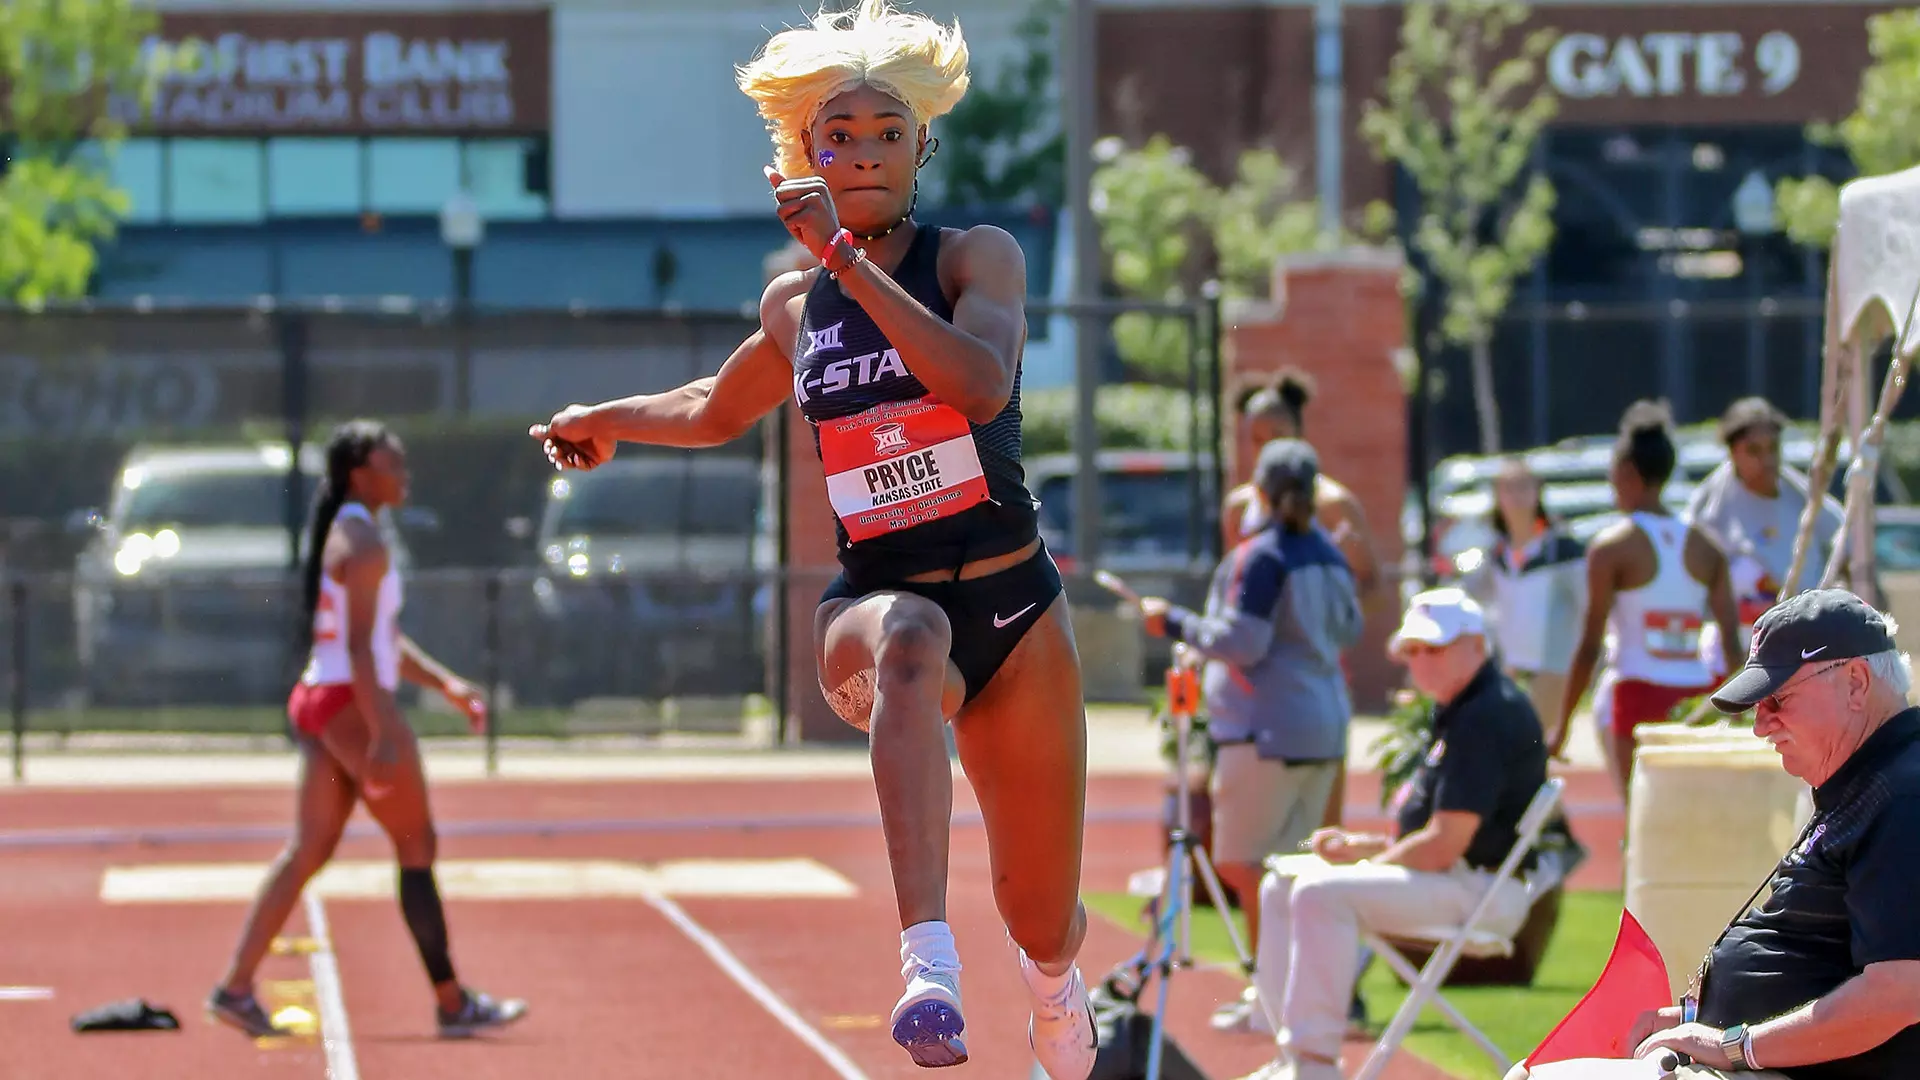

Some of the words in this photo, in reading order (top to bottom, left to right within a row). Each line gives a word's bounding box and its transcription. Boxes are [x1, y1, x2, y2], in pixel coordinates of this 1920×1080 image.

[1547, 31, 1746, 97] GATE
[1755, 30, 1801, 95] 9
[803, 321, 844, 358] XII
[793, 348, 914, 408] K-STA
[836, 422, 856, 433] Track
[864, 414, 881, 426] Field
[882, 404, 937, 420] Championship
[864, 449, 940, 494] PRYCE
[860, 507, 905, 525] University
[908, 504, 916, 513] of
[918, 490, 962, 510] Oklahoma
[872, 487, 911, 507] KANSAS
[912, 477, 943, 496] STATE
[889, 519, 908, 530] May
[911, 508, 939, 524] 10-12
